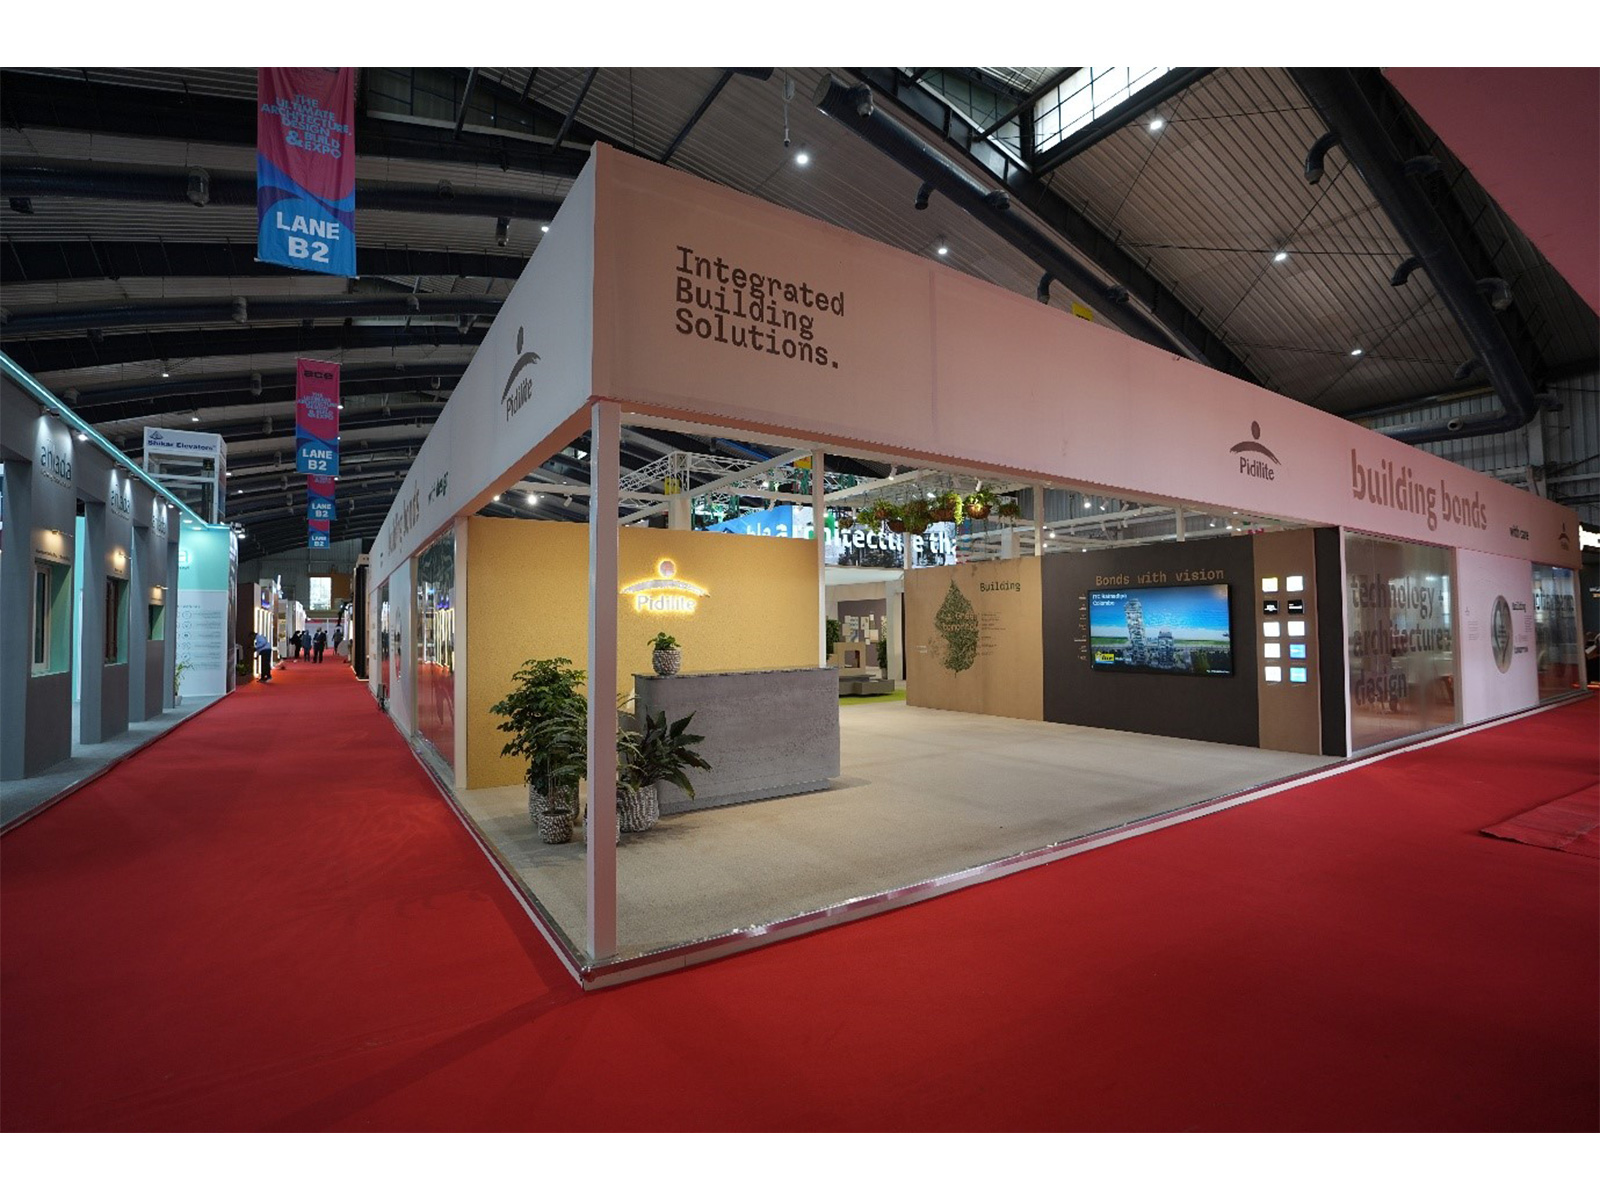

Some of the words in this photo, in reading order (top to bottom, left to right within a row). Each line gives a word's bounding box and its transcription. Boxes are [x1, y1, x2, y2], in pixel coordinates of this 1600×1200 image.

[276, 97, 335, 120] ULTIMATE
[295, 94, 318, 107] THE
[281, 116, 330, 137] DESIGN
[305, 141, 341, 158] EXPO
[276, 211, 340, 241] LANE
[288, 235, 330, 264] B2
[676, 245, 844, 317] Integrated
[676, 276, 814, 341] Building
[675, 307, 839, 370] Solutions.
[506, 377, 532, 422] Pidilite
[302, 448, 333, 460] LANE
[308, 459, 327, 471] B2
[1239, 456, 1275, 480] Pidilite
[1351, 448, 1437, 532] building
[1440, 479, 1488, 531] bonds
[315, 509, 329, 518] B2
[979, 580, 1021, 592] Building
[1095, 573, 1130, 586] Bonds
[1138, 571, 1167, 584] with
[1175, 568, 1224, 582] vision
[636, 594, 696, 612] Pidilite
[1350, 574, 1435, 619] technology
